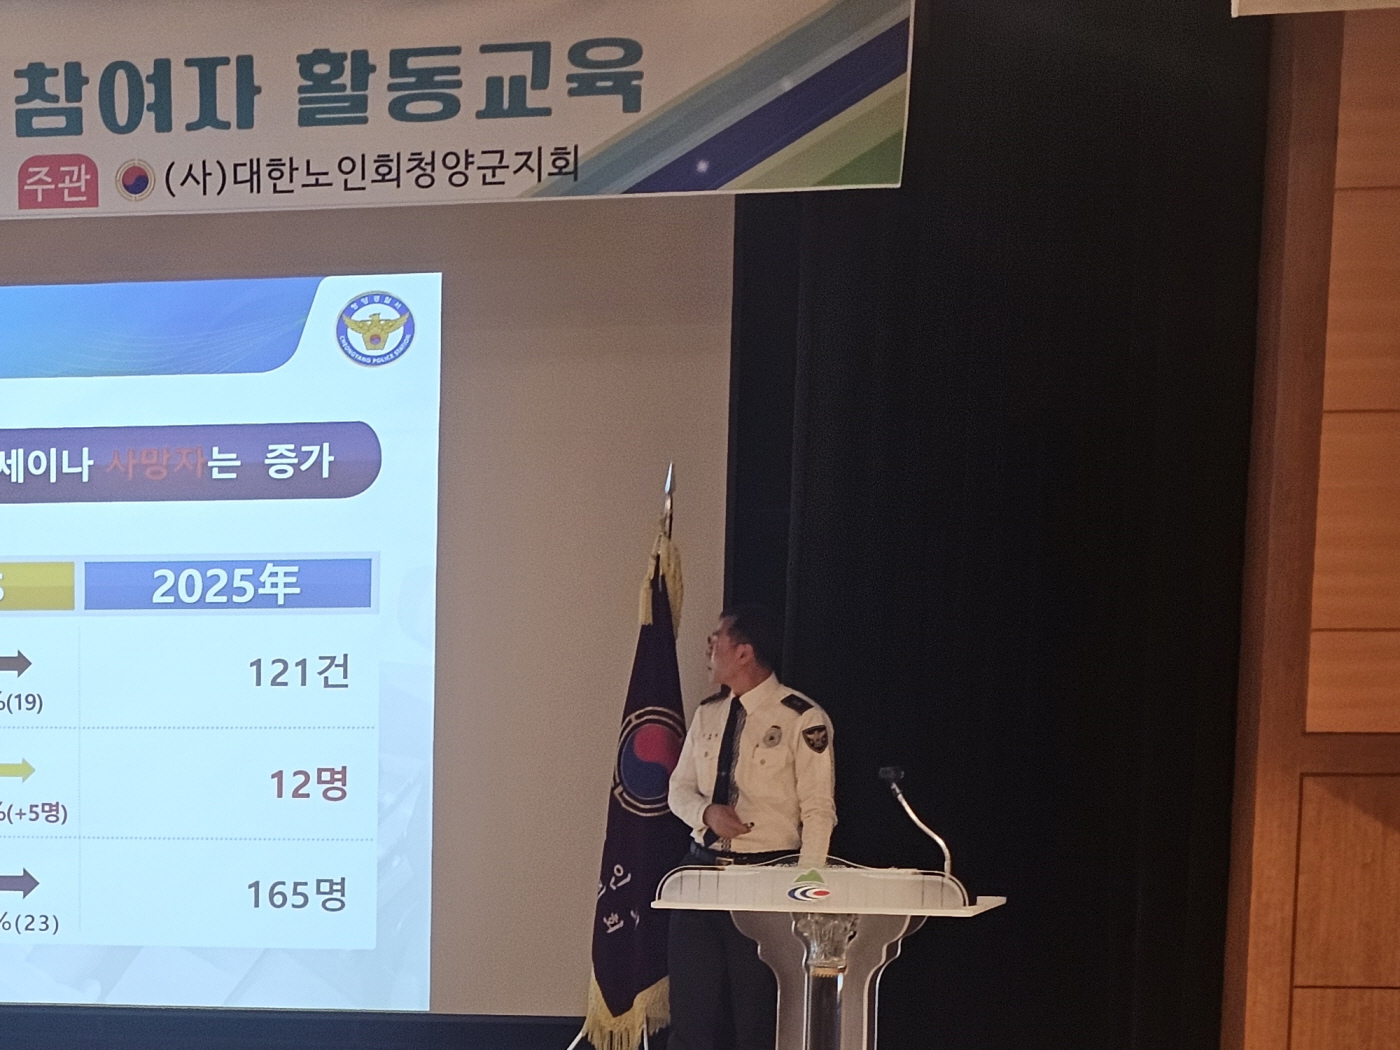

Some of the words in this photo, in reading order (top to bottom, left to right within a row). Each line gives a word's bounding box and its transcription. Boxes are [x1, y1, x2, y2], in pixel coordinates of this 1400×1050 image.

[14, 53, 263, 138] 참여자
[297, 36, 645, 126] 활동교육
[23, 166, 92, 204] 주관
[164, 143, 581, 198] (사)대한노인회청양군지회
[263, 441, 335, 479] 증가
[152, 562, 302, 606] 2025年
[249, 653, 351, 690] 121건
[270, 764, 349, 802] 12명
[247, 876, 347, 913] 165명
